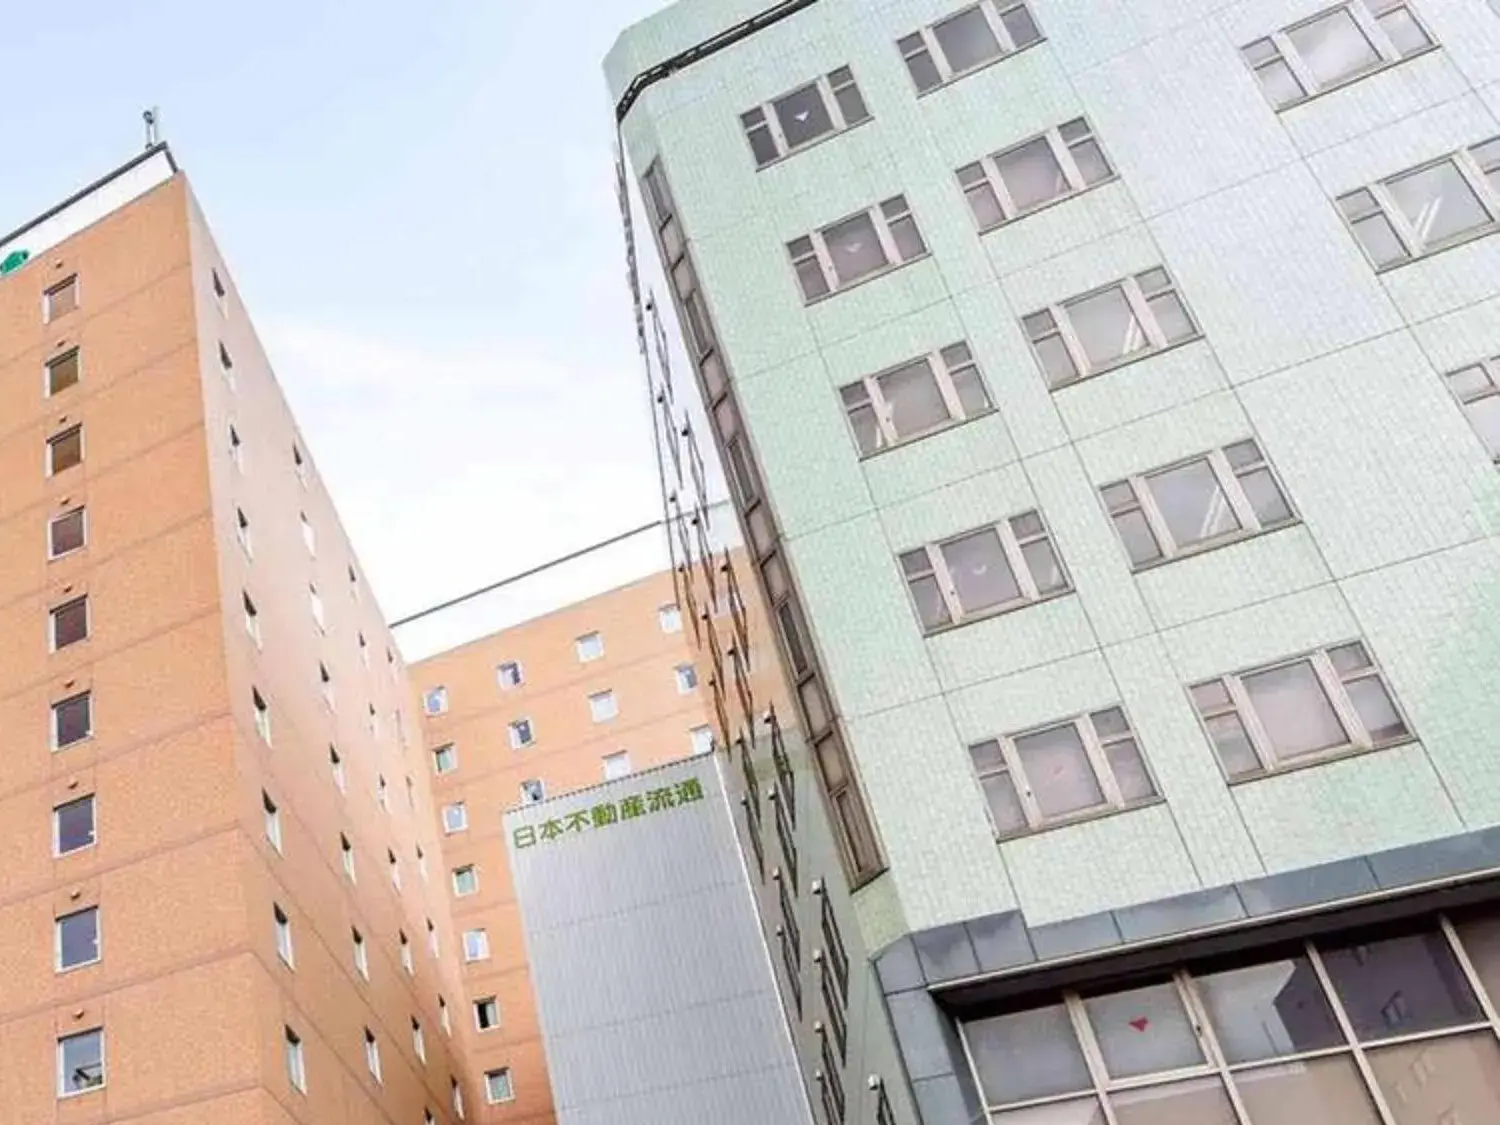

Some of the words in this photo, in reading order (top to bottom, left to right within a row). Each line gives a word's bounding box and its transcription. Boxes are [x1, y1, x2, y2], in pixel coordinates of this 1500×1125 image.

[513, 777, 705, 849] 日本不動産流通
